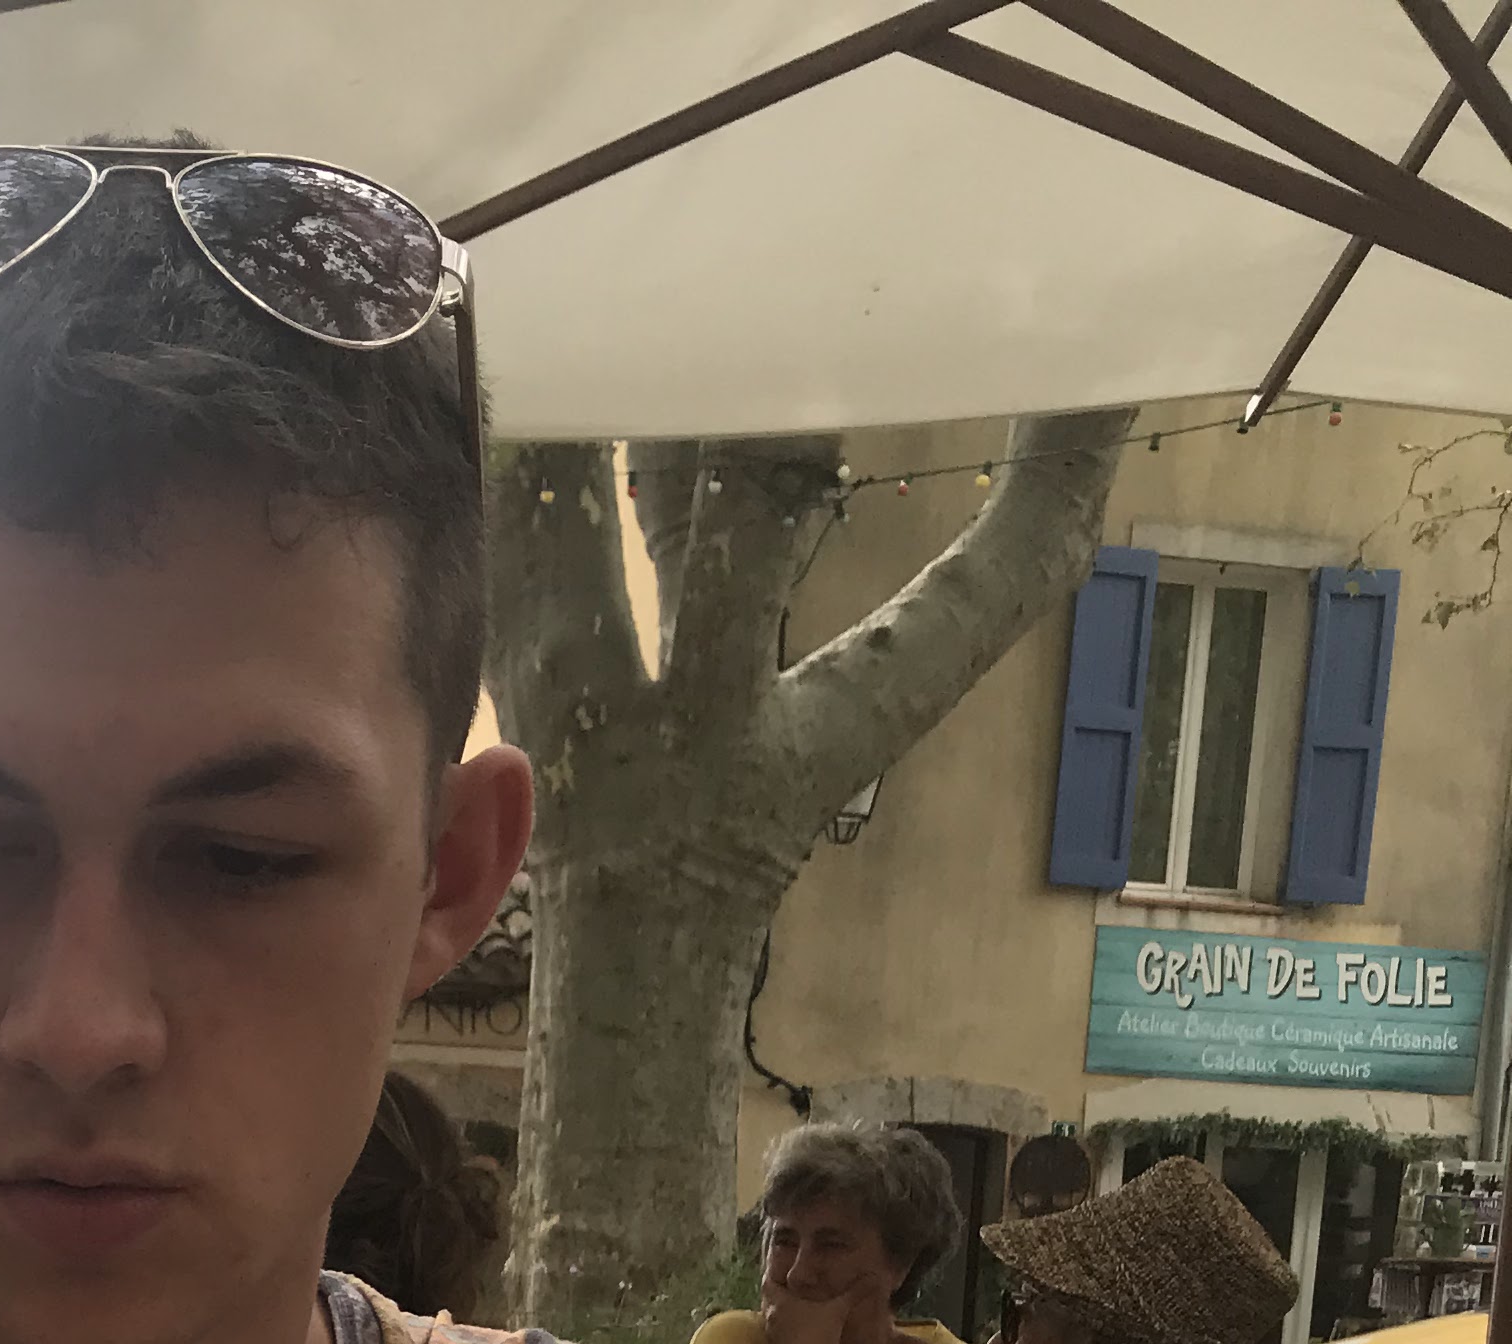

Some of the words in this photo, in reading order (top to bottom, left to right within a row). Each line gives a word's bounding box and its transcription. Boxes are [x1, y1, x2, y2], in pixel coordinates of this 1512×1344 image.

[1137, 942, 1252, 1009] GRAIN
[1267, 947, 1321, 1000] DE
[1336, 953, 1453, 1007] FOLIE
[1117, 1010, 1178, 1034] Atelier
[1184, 1012, 1265, 1046] Boutique
[1271, 1016, 1364, 1051] Céramique
[1369, 1024, 1458, 1050] Artisanale
[1201, 1047, 1278, 1073] Cadeaux
[1288, 1049, 1371, 1078] Souvenirs
